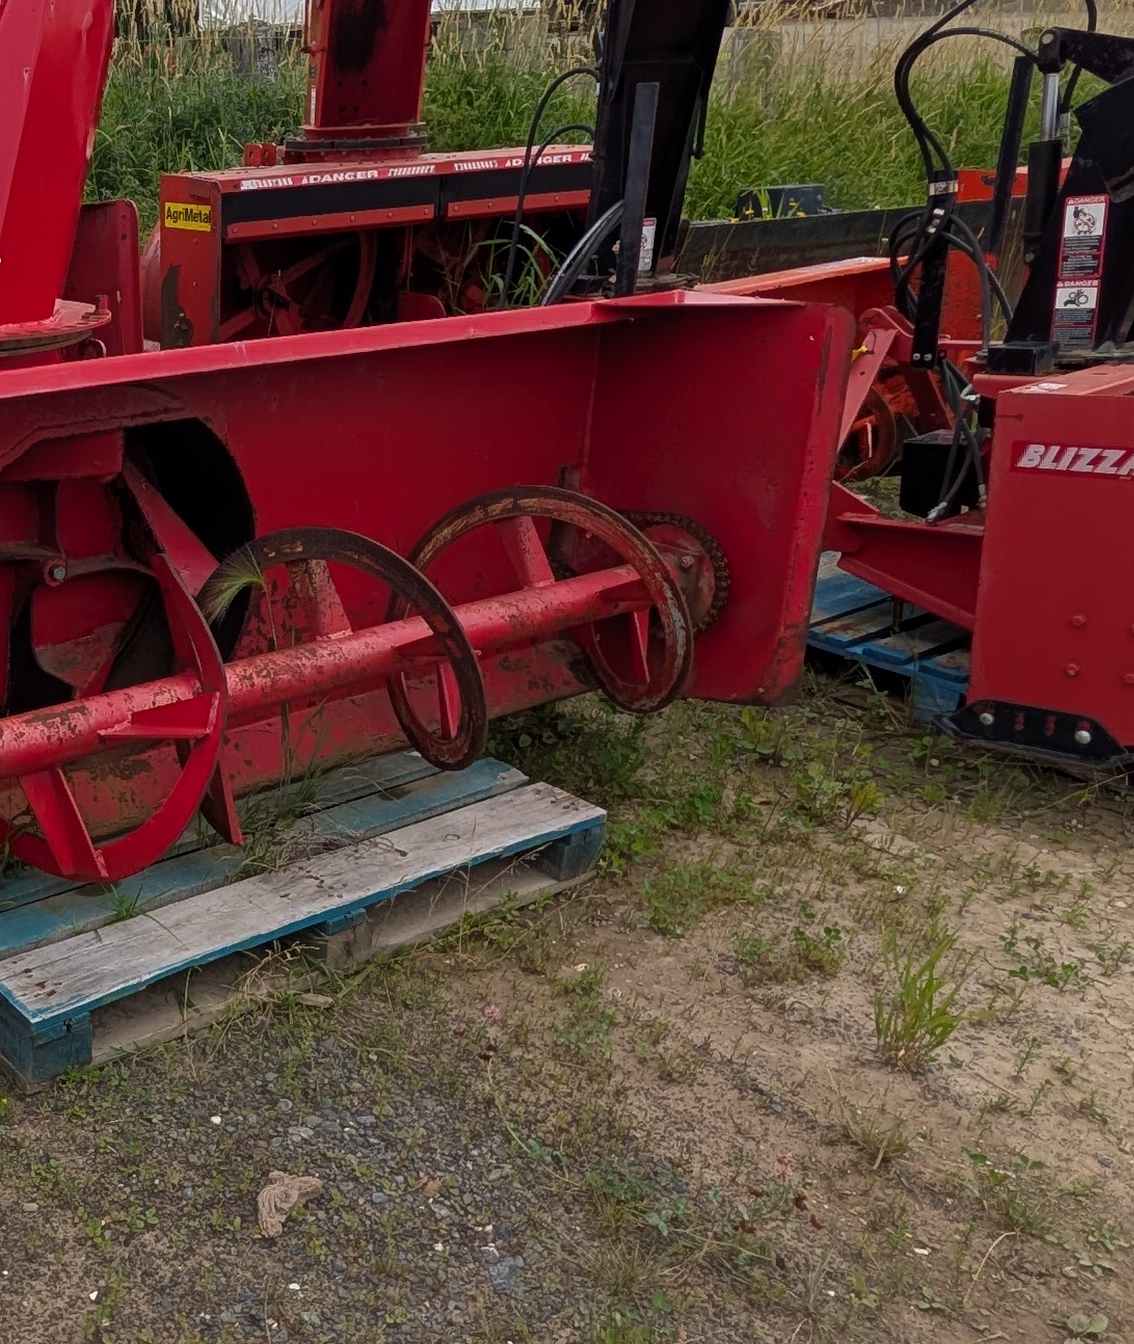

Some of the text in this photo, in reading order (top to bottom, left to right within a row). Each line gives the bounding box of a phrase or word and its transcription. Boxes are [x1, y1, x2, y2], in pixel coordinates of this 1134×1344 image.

[308, 170, 379, 184] DANGER
[1074, 196, 1106, 204] DANGER
[166, 206, 211, 224] AgriMetal
